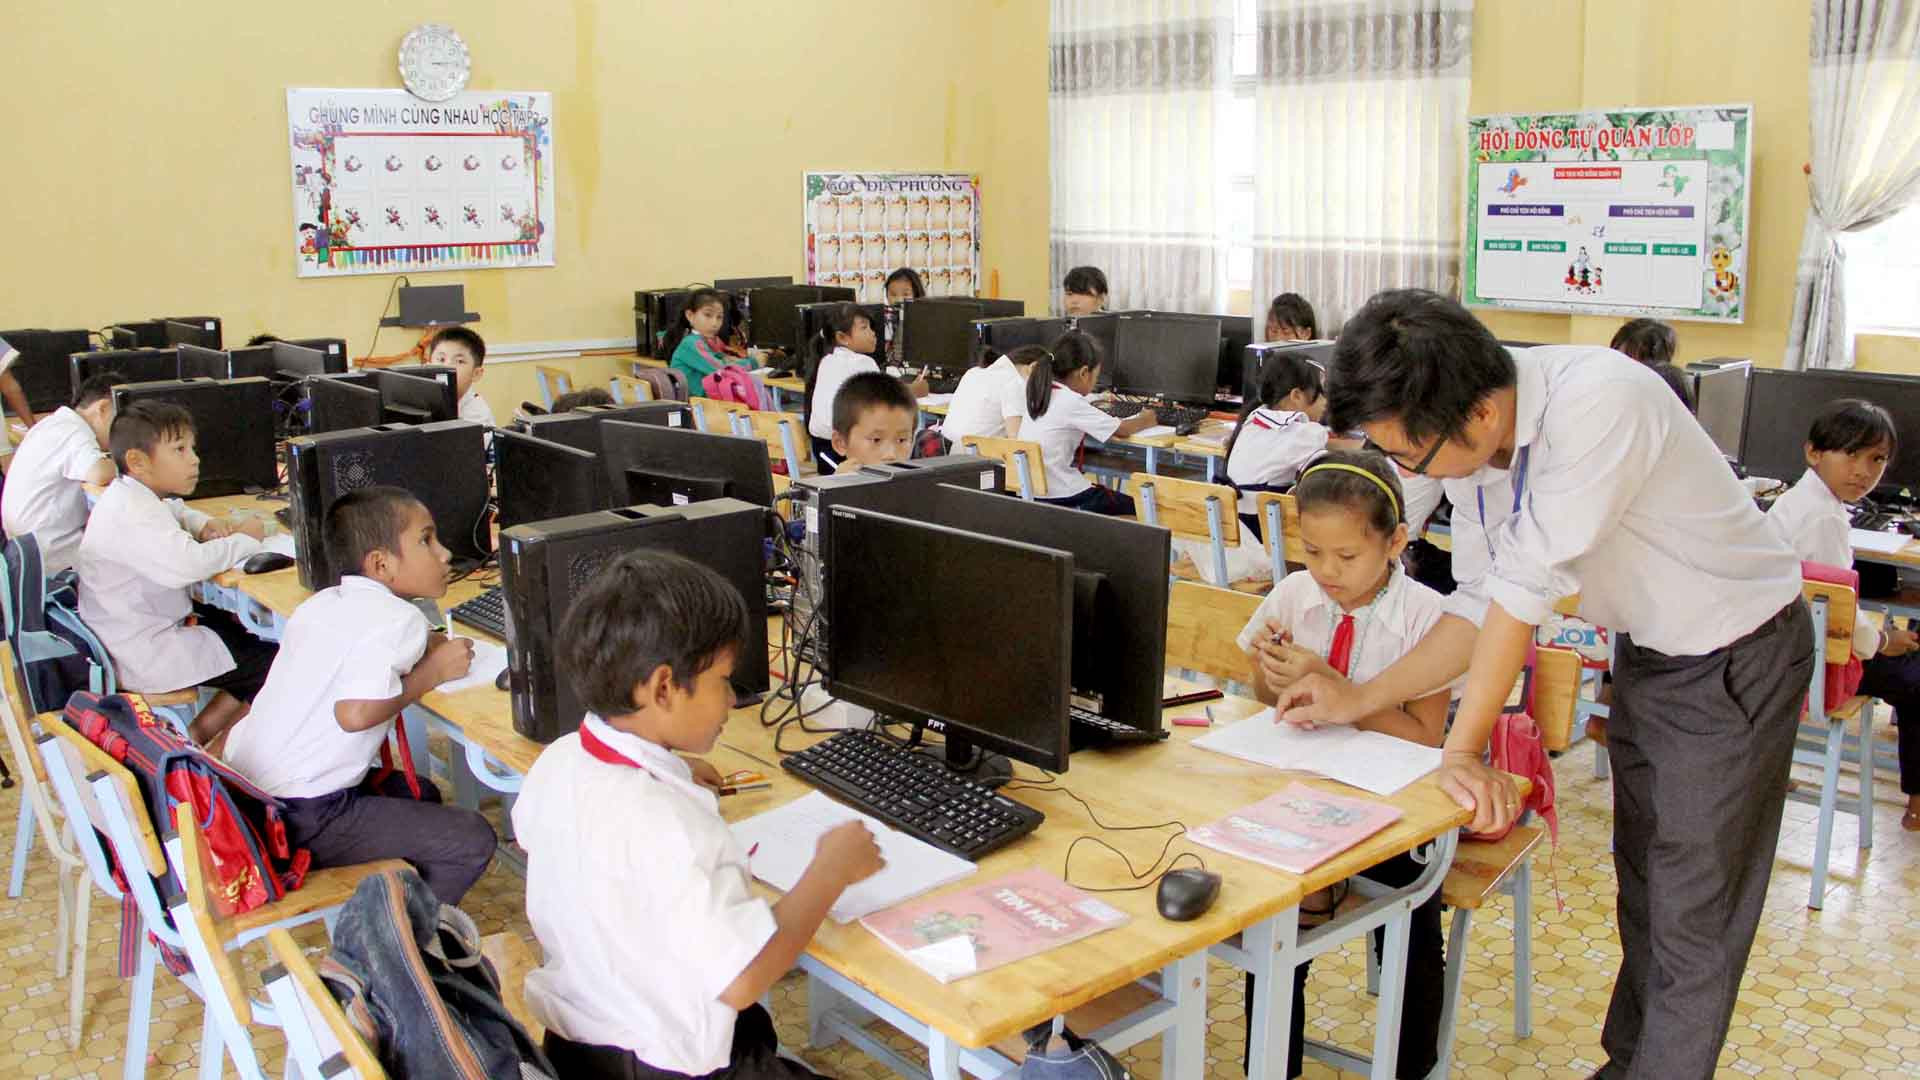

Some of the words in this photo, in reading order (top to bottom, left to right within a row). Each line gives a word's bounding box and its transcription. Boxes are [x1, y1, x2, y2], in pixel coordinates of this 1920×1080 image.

[363, 103, 397, 125] MÌNH
[400, 103, 441, 125] CÙNG
[444, 107, 479, 125] NHAU
[1480, 127, 1510, 154] HỘI
[1514, 121, 1564, 150] ĐỒNG
[1568, 123, 1595, 152] TỰ
[1597, 120, 1652, 152] QUẢN
[1656, 118, 1695, 147] LỚP
[928, 719, 945, 731] FPT
